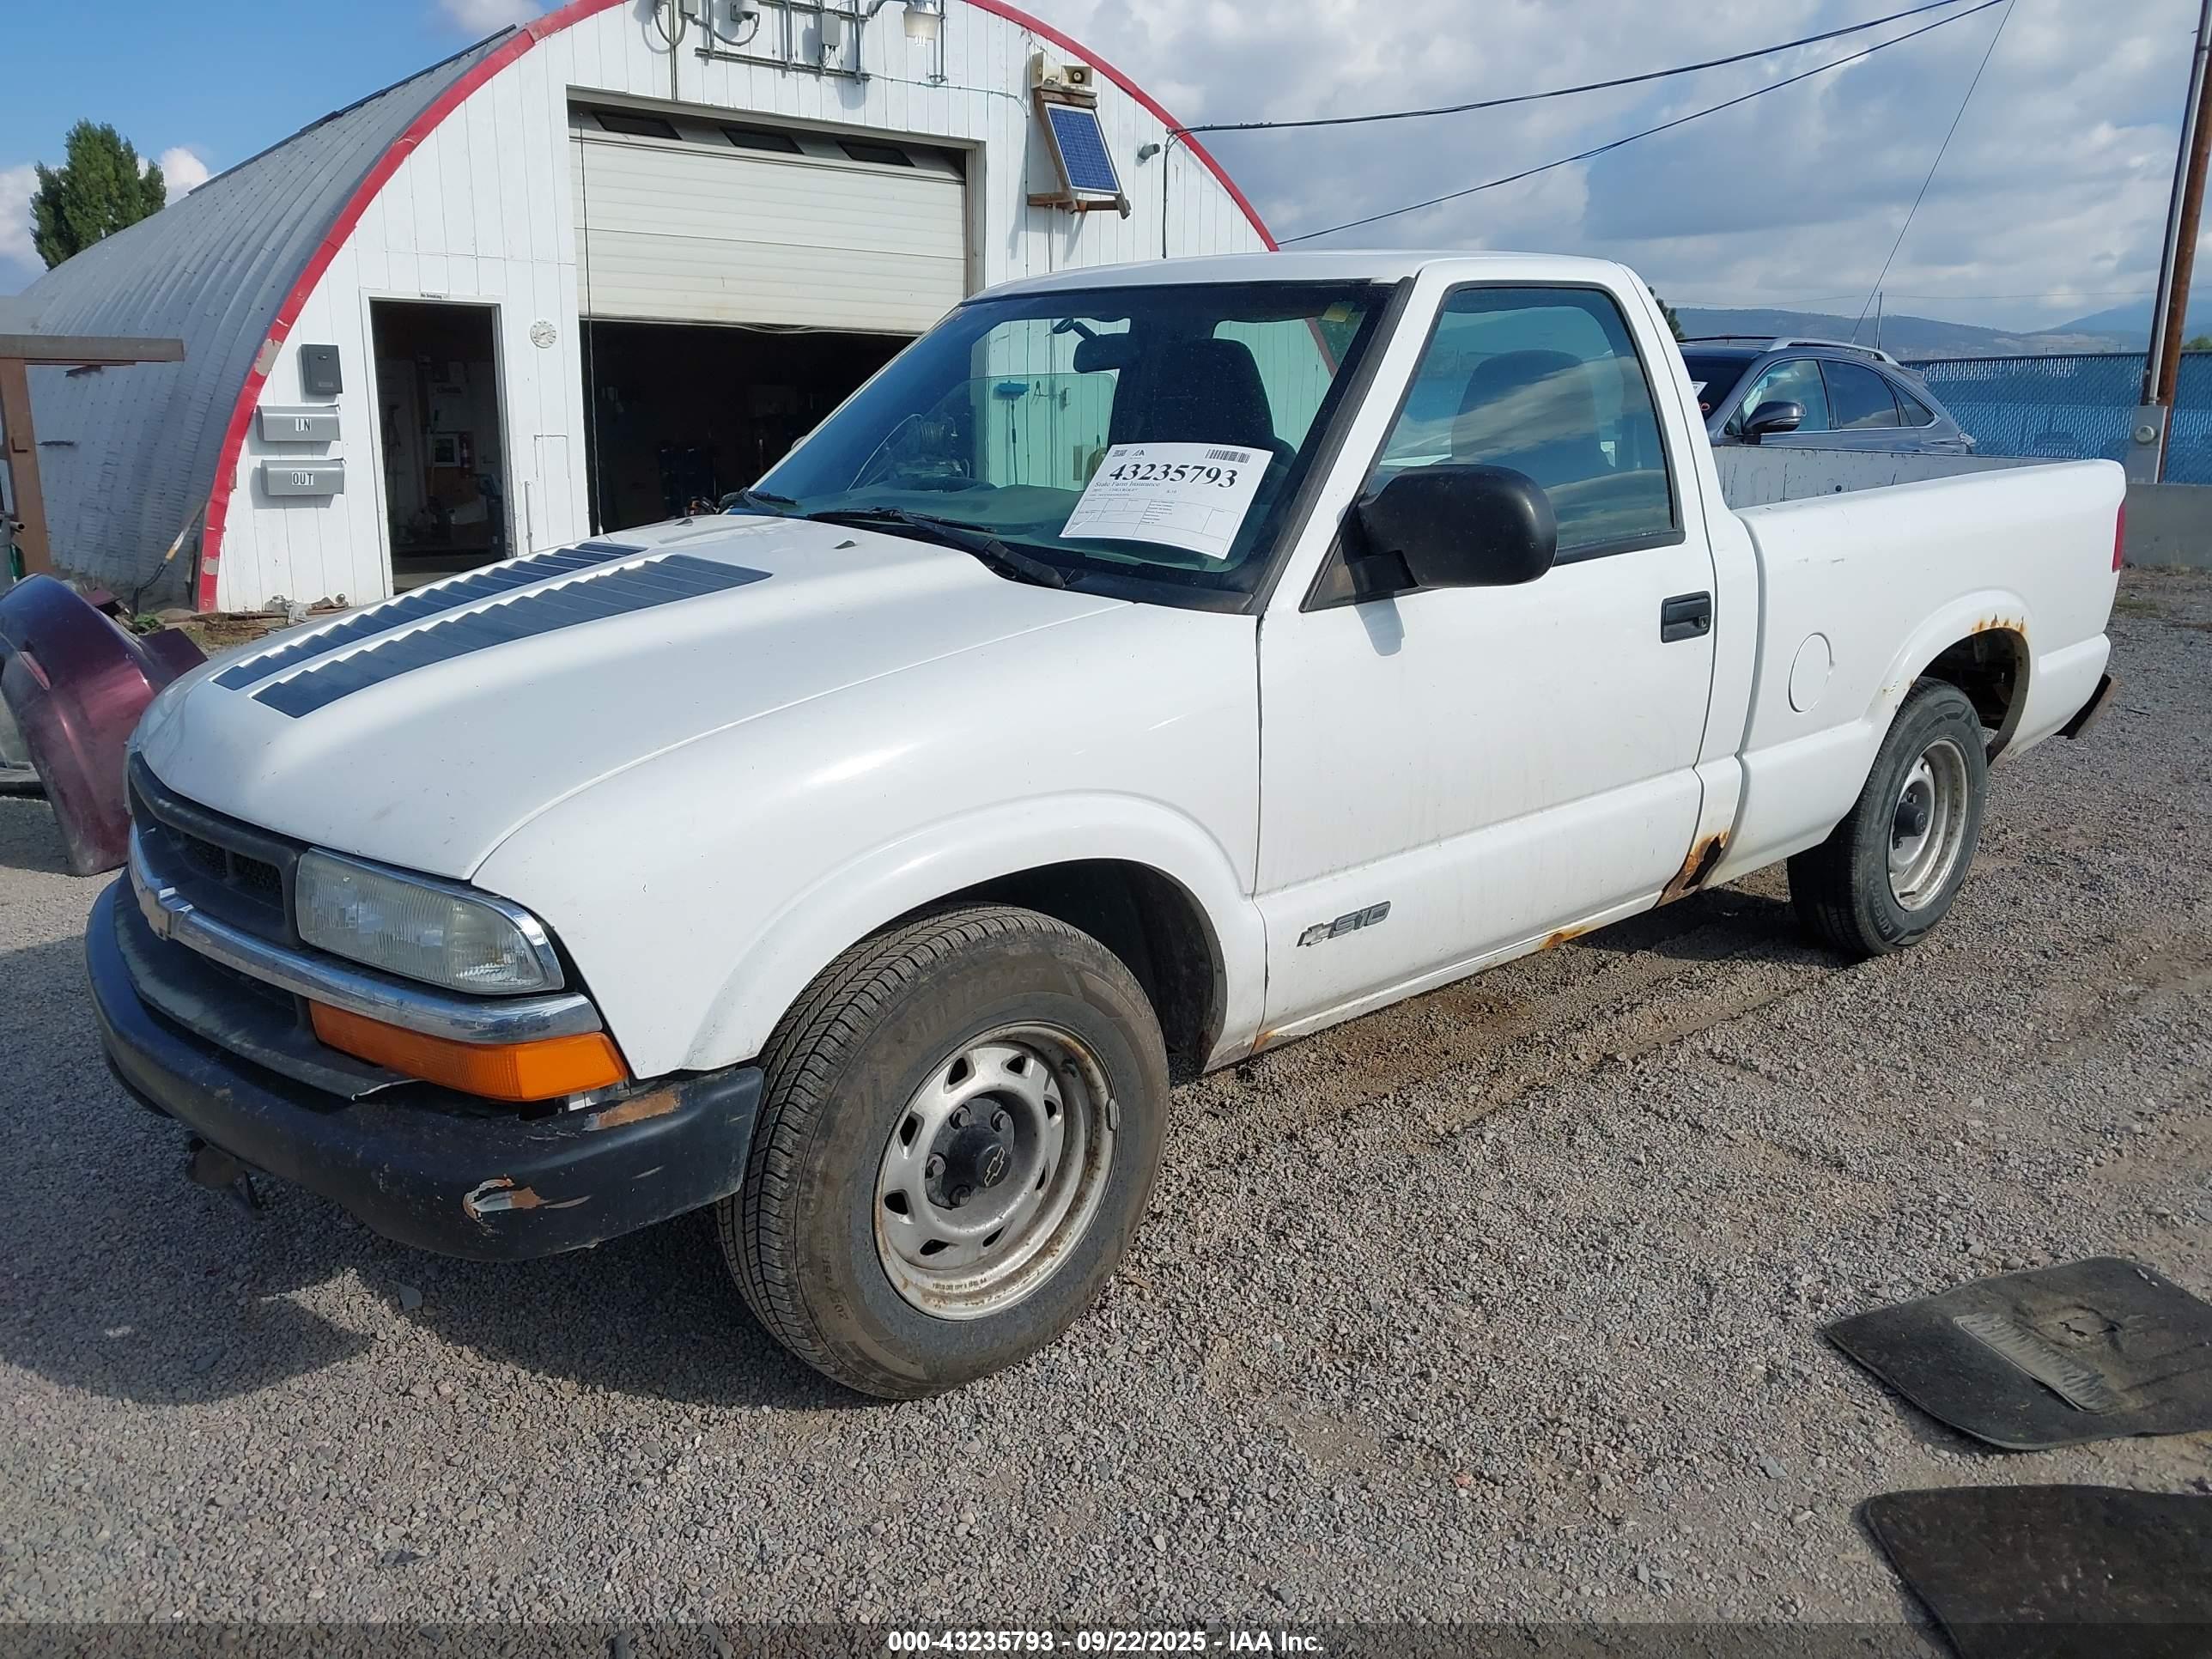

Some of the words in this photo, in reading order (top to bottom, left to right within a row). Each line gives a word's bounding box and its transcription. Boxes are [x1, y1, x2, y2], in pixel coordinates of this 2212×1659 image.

[298, 419, 310, 430] IN
[293, 473, 313, 485] OUT
[1109, 464, 1238, 489] 43235793
